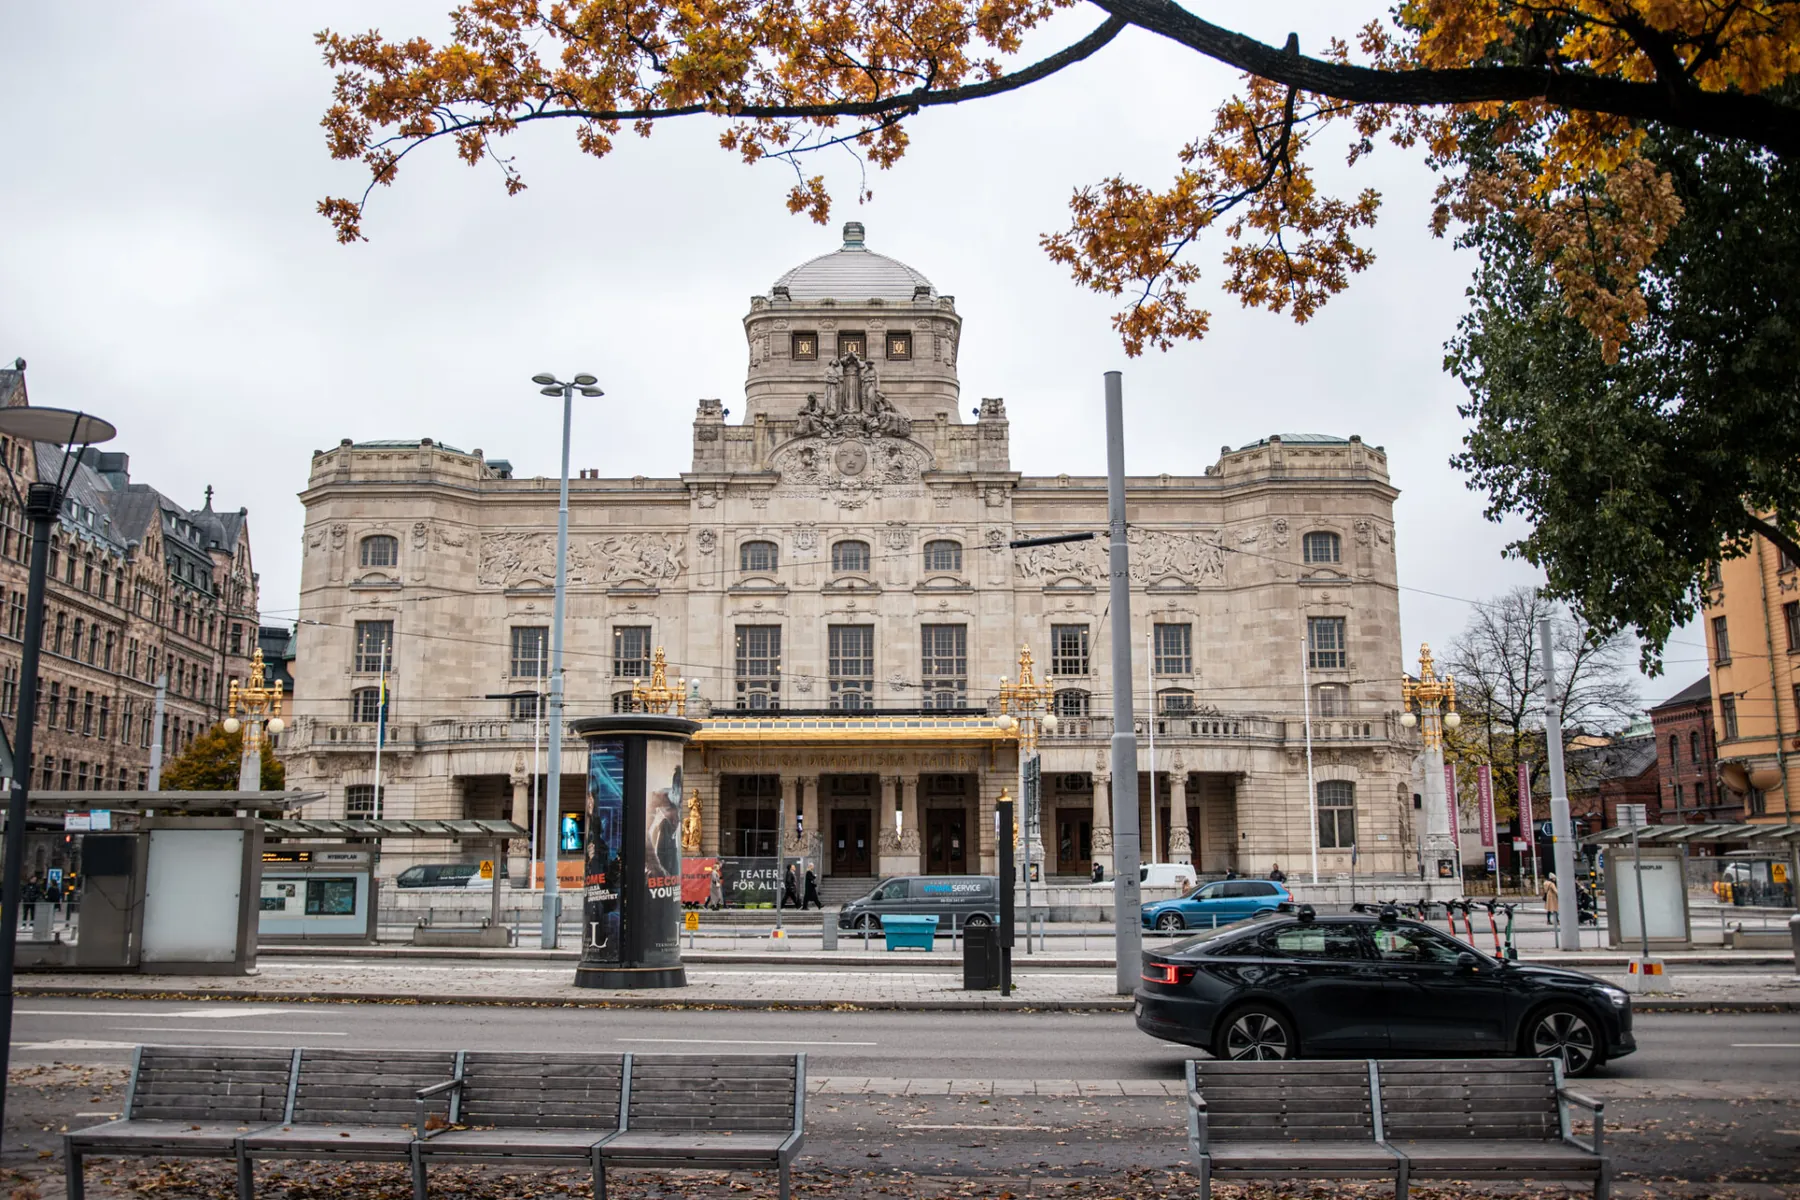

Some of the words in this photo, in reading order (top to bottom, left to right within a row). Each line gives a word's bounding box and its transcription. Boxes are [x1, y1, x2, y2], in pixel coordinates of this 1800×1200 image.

[720, 753, 802, 769] KUNGLIGA
[808, 753, 906, 768] DRAMATISKA
[912, 753, 979, 768] TEATERN
[740, 869, 779, 879] TEATER
[732, 879, 755, 891] FÖR
[649, 886, 673, 899] YOU
[589, 921, 609, 948] L
